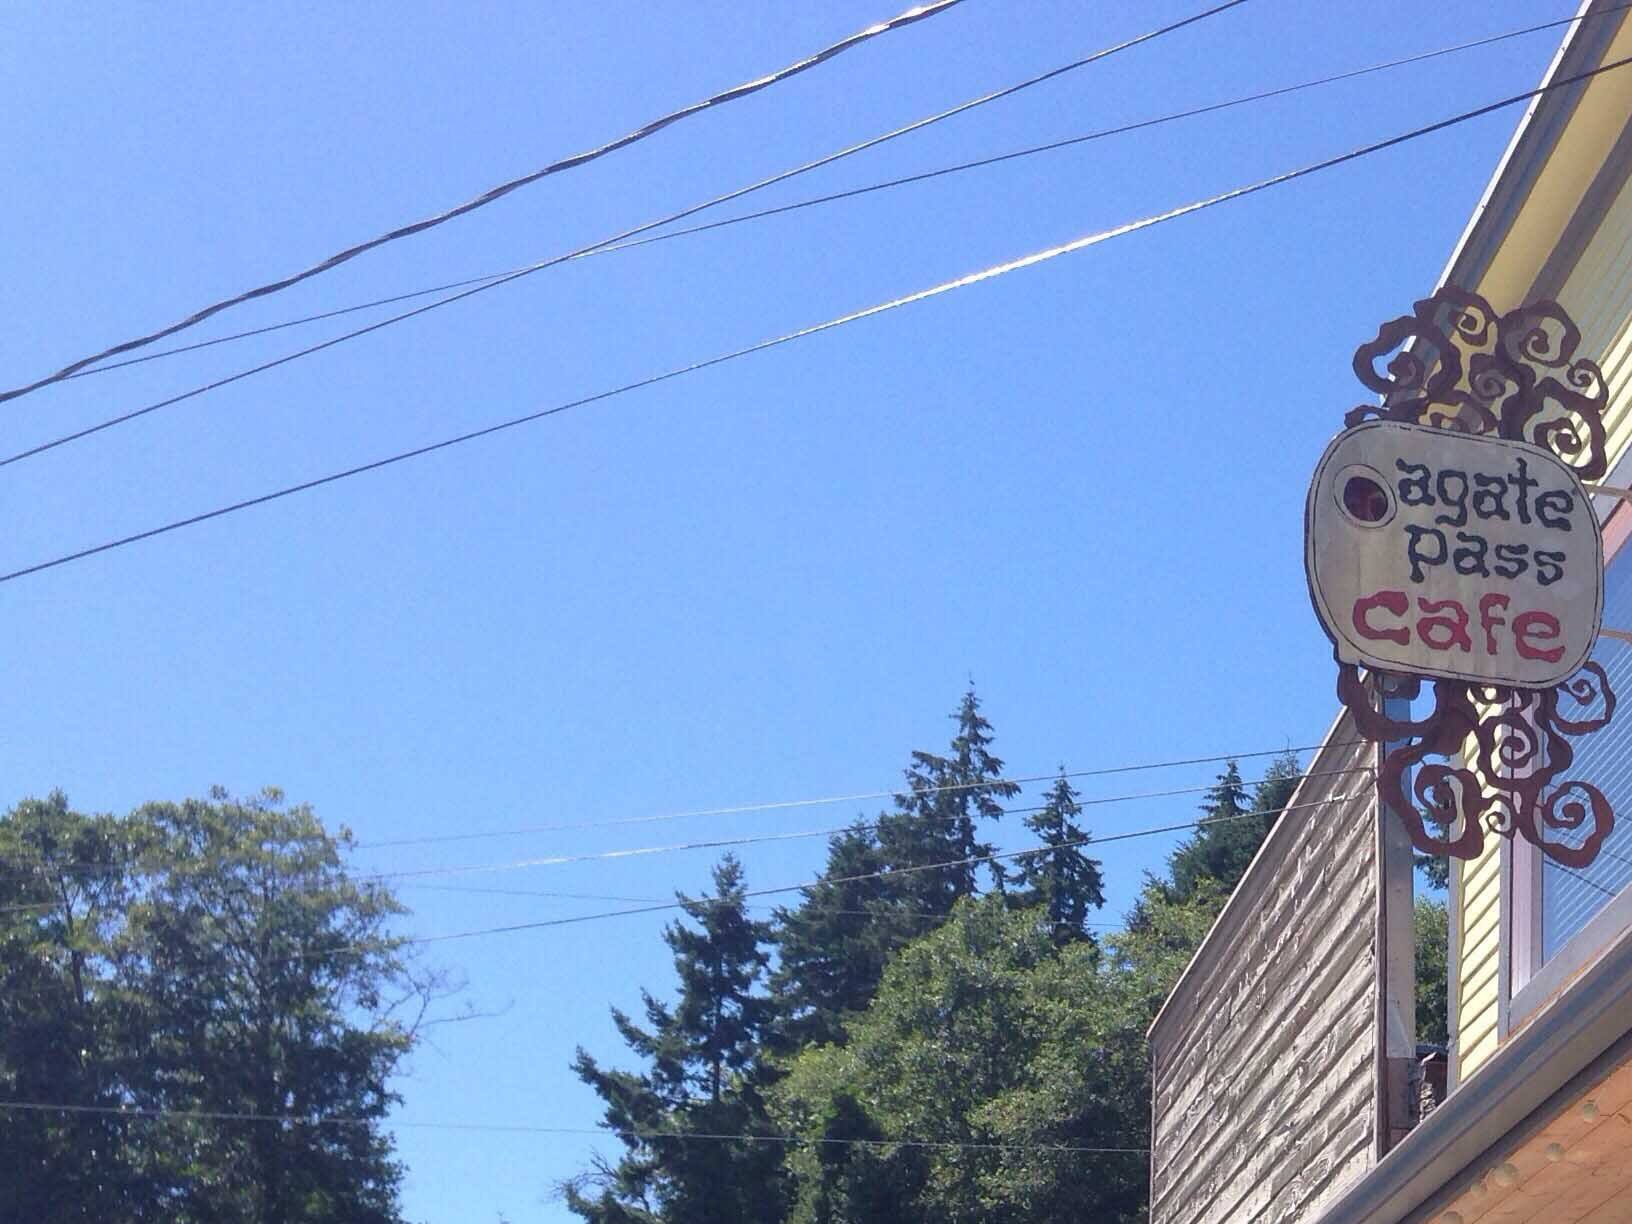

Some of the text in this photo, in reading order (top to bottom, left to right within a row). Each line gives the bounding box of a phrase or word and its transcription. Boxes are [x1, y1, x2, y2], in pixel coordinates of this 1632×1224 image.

[1396, 457, 1576, 531] agate
[1404, 524, 1566, 586] pass
[1352, 590, 1566, 663] cafe
